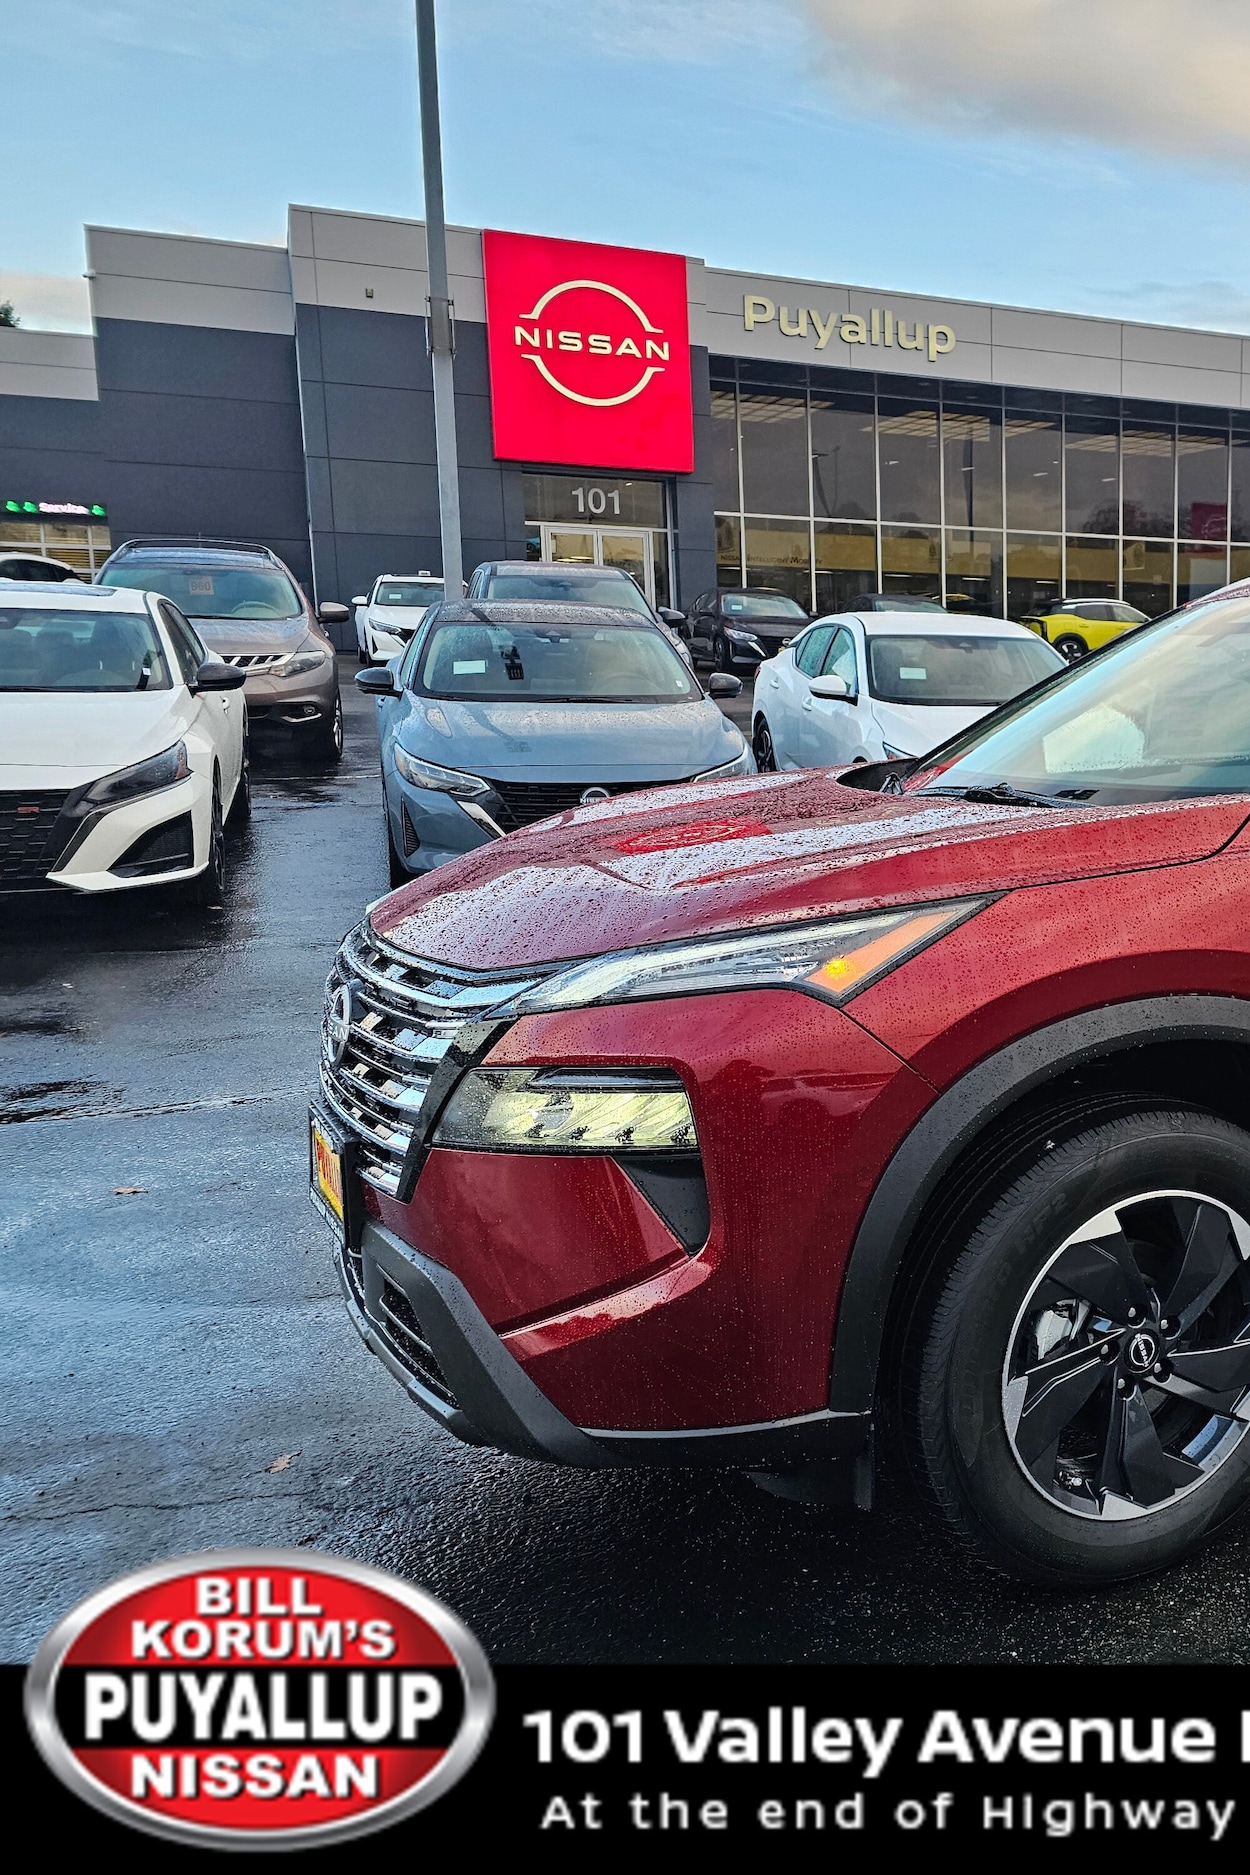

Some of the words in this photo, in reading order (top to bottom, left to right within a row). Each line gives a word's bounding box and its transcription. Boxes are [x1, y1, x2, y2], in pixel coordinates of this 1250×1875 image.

[514, 325, 670, 361] NISSAN
[743, 294, 956, 362] Puyallup
[572, 487, 620, 514] 101
